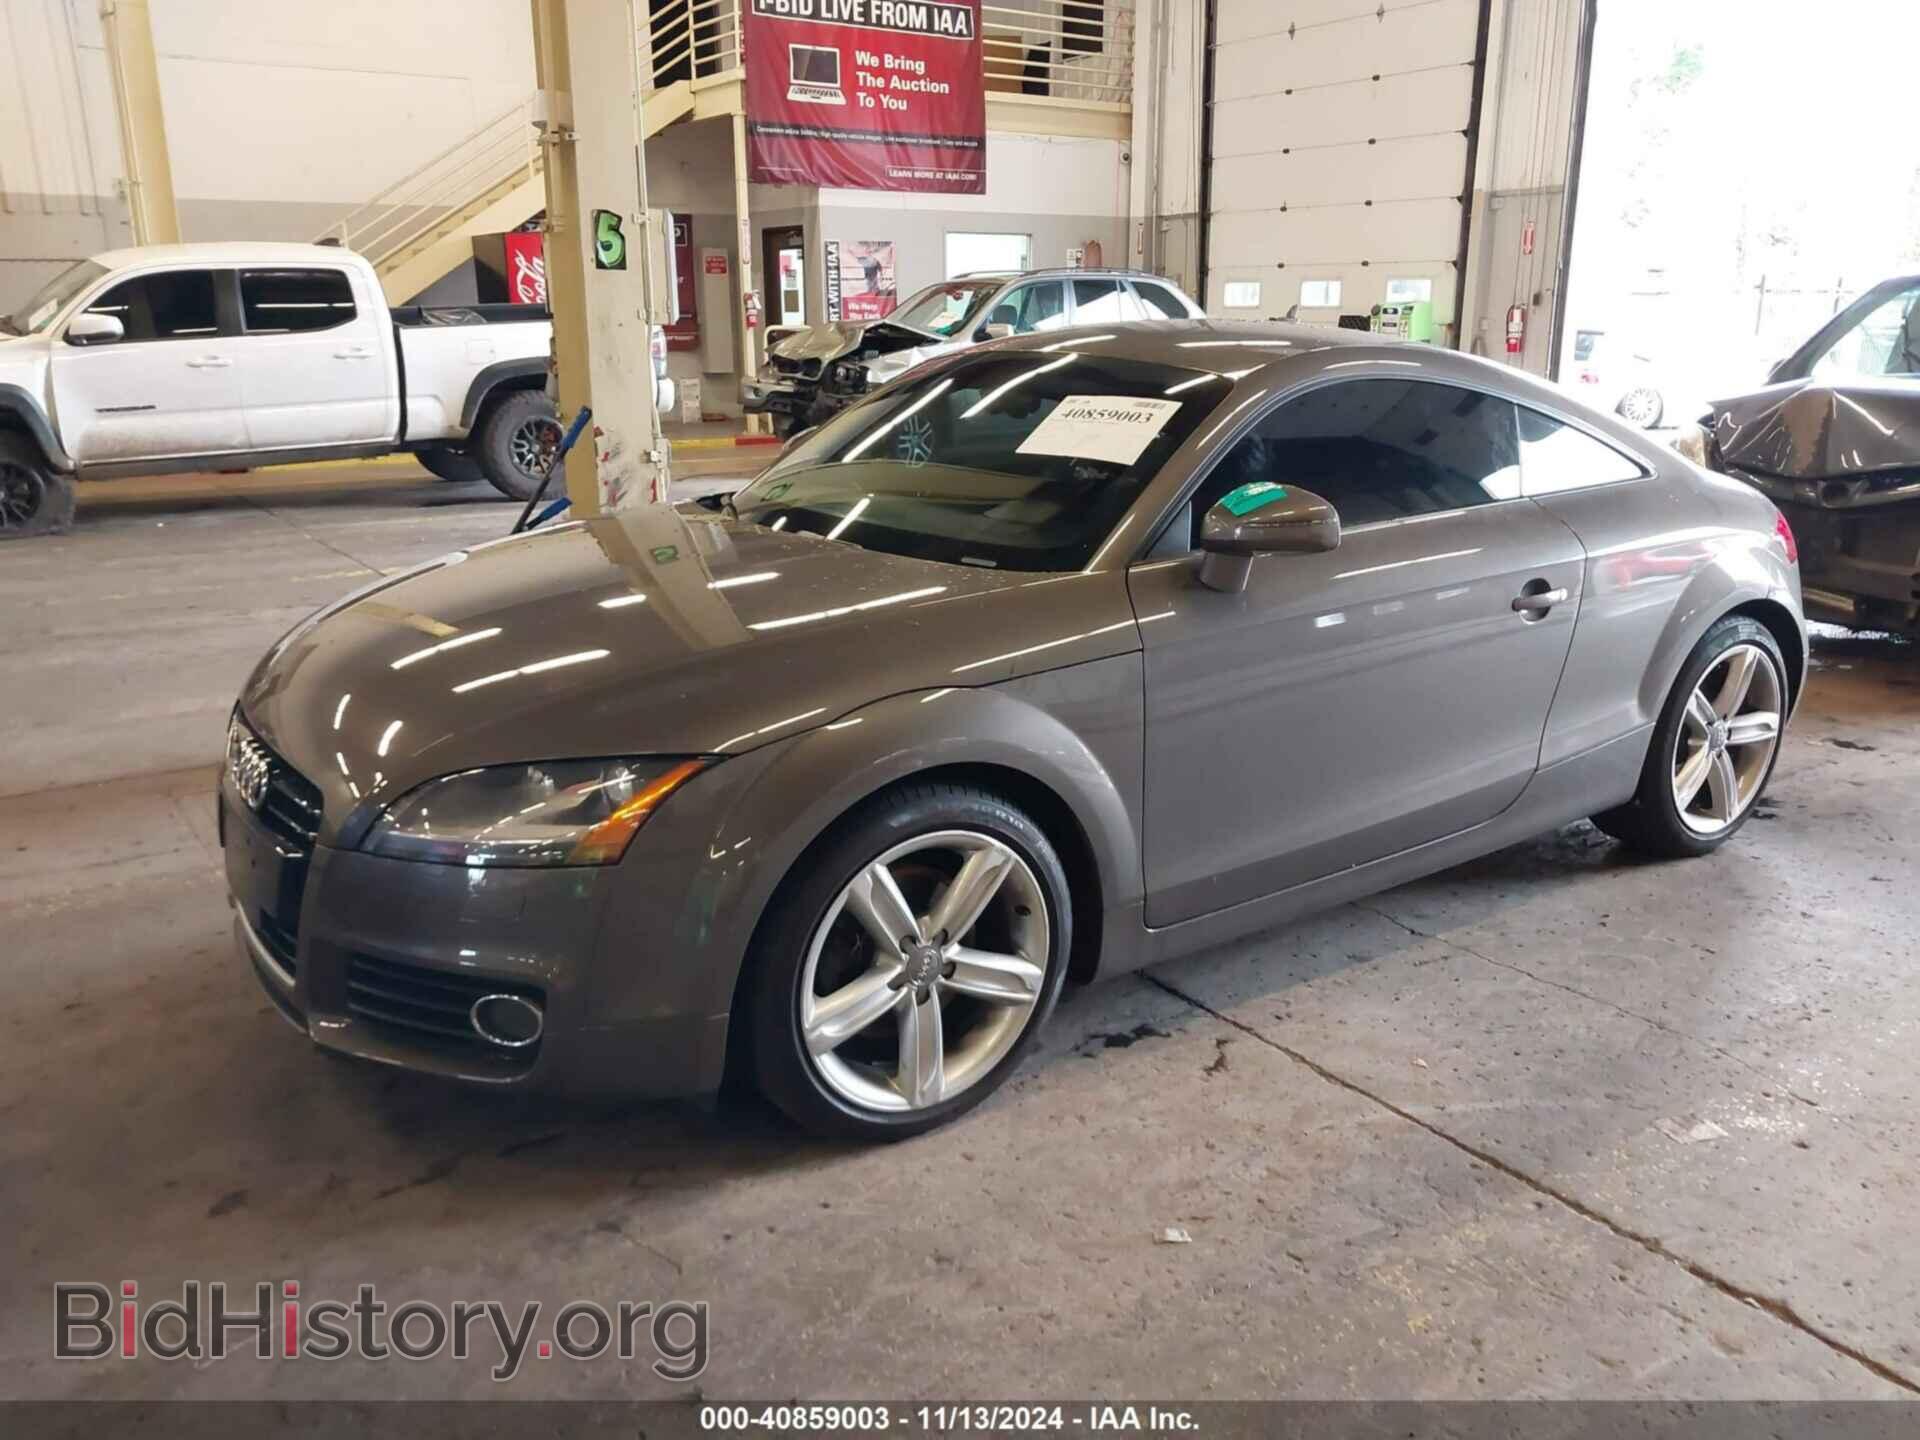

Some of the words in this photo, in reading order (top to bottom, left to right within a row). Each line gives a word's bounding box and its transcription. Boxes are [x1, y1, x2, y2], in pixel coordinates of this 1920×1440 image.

[820, 0, 865, 22] LIVE
[870, 5, 927, 30] FROM
[933, 8, 968, 35] IAA
[855, 50, 880, 68] We
[883, 53, 926, 75] Bring
[856, 71, 885, 88] The
[890, 74, 950, 94] Auction
[856, 91, 875, 108] To
[879, 94, 908, 110] You
[828, 268, 840, 304] WITH
[1061, 407, 1154, 424] 40859003
